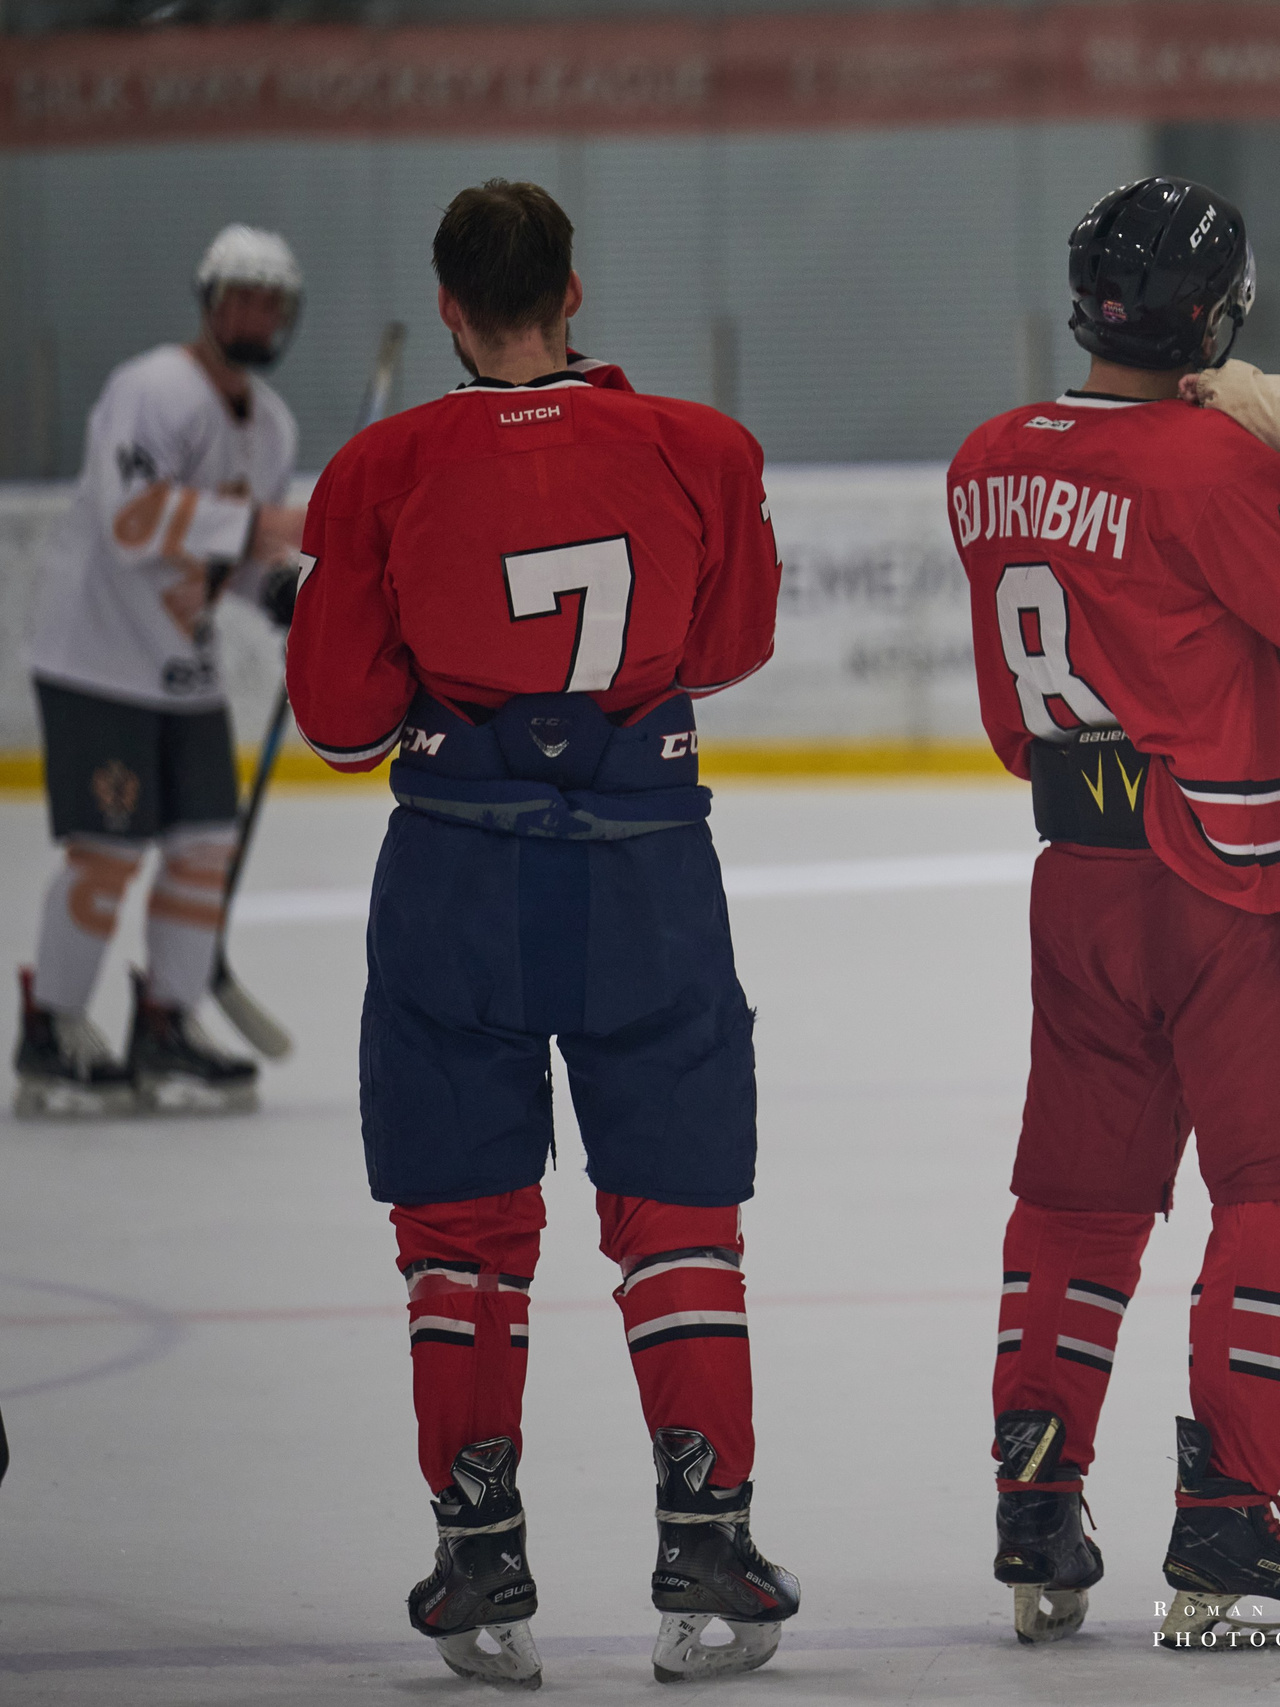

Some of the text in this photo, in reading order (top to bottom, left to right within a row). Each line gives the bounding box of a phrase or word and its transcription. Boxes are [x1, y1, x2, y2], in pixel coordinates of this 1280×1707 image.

[1189, 204, 1217, 249] CCM
[500, 405, 561, 424] LUTCH
[953, 475, 1131, 560] ВОЛКОВИЧ
[501, 532, 635, 694] 7
[996, 561, 1119, 743] 8
[399, 727, 446, 757] CM
[494, 1583, 535, 1603] BAUE
[745, 1571, 777, 1595] BAUER
